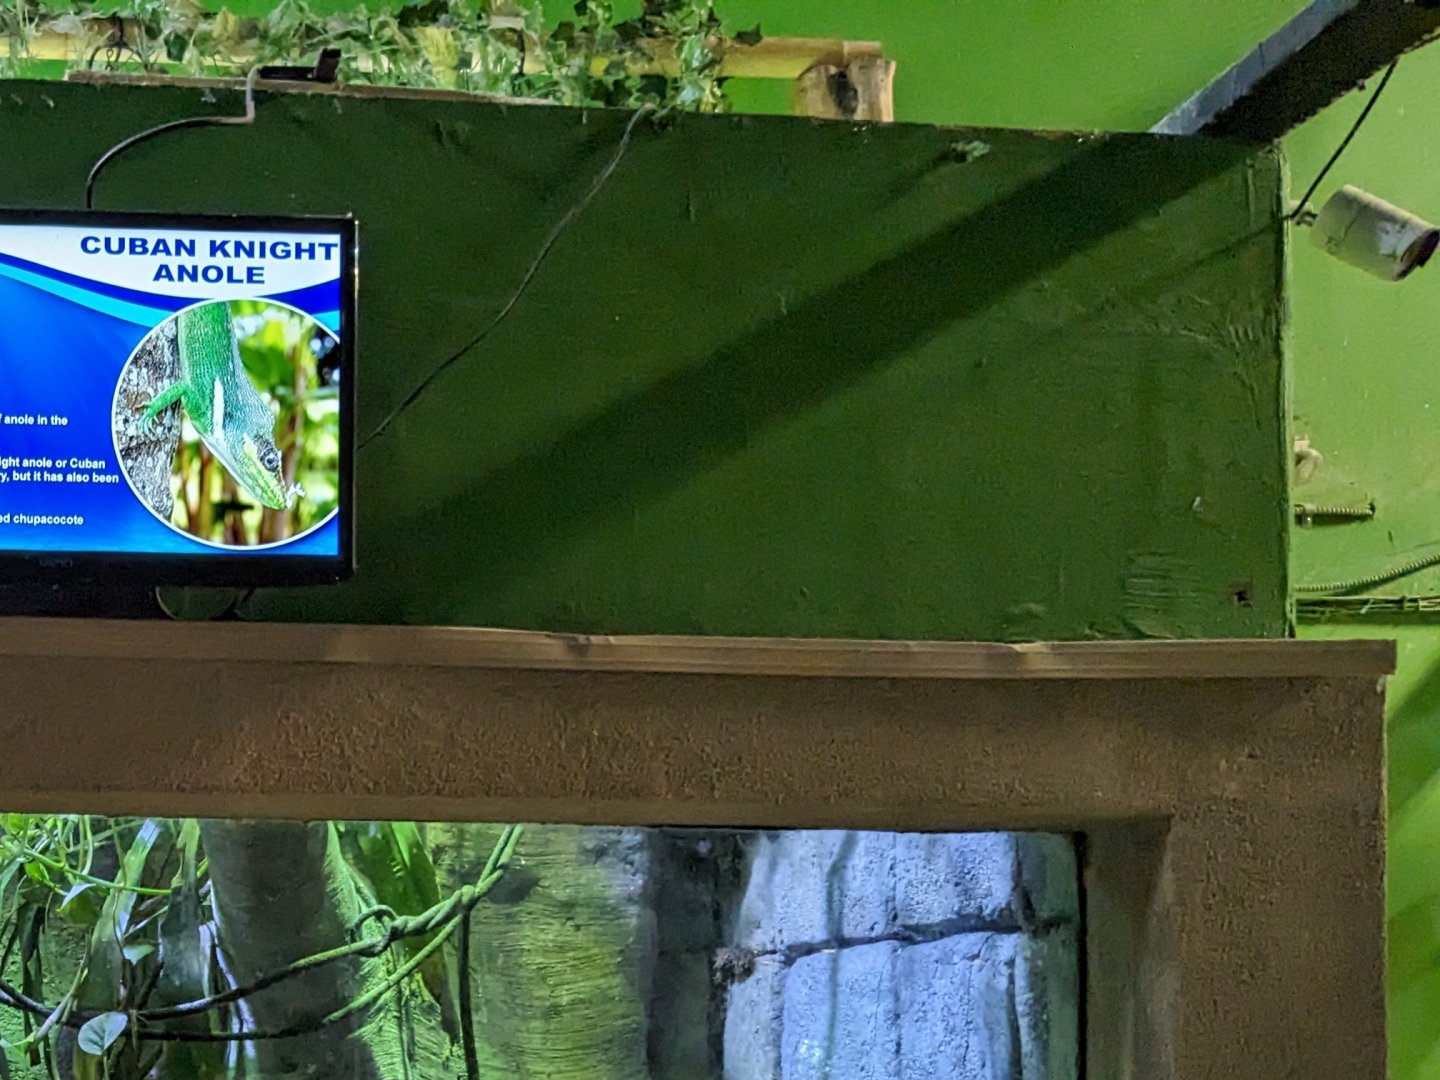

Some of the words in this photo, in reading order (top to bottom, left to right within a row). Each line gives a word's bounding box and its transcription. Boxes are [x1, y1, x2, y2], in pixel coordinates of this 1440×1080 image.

[81, 236, 195, 256] CUBAN
[210, 240, 338, 260] KNIGHT
[153, 264, 264, 284] ANOLE
[4, 414, 34, 425] anole
[38, 415, 47, 425] in
[51, 415, 68, 426] the
[22, 457, 52, 468] anole
[55, 460, 67, 469] or
[70, 458, 105, 469] Cuban
[13, 470, 31, 482] but
[34, 471, 41, 482] it
[44, 471, 63, 483] has
[66, 472, 89, 483] also
[93, 472, 119, 484] been
[13, 514, 83, 526] chupacocote
